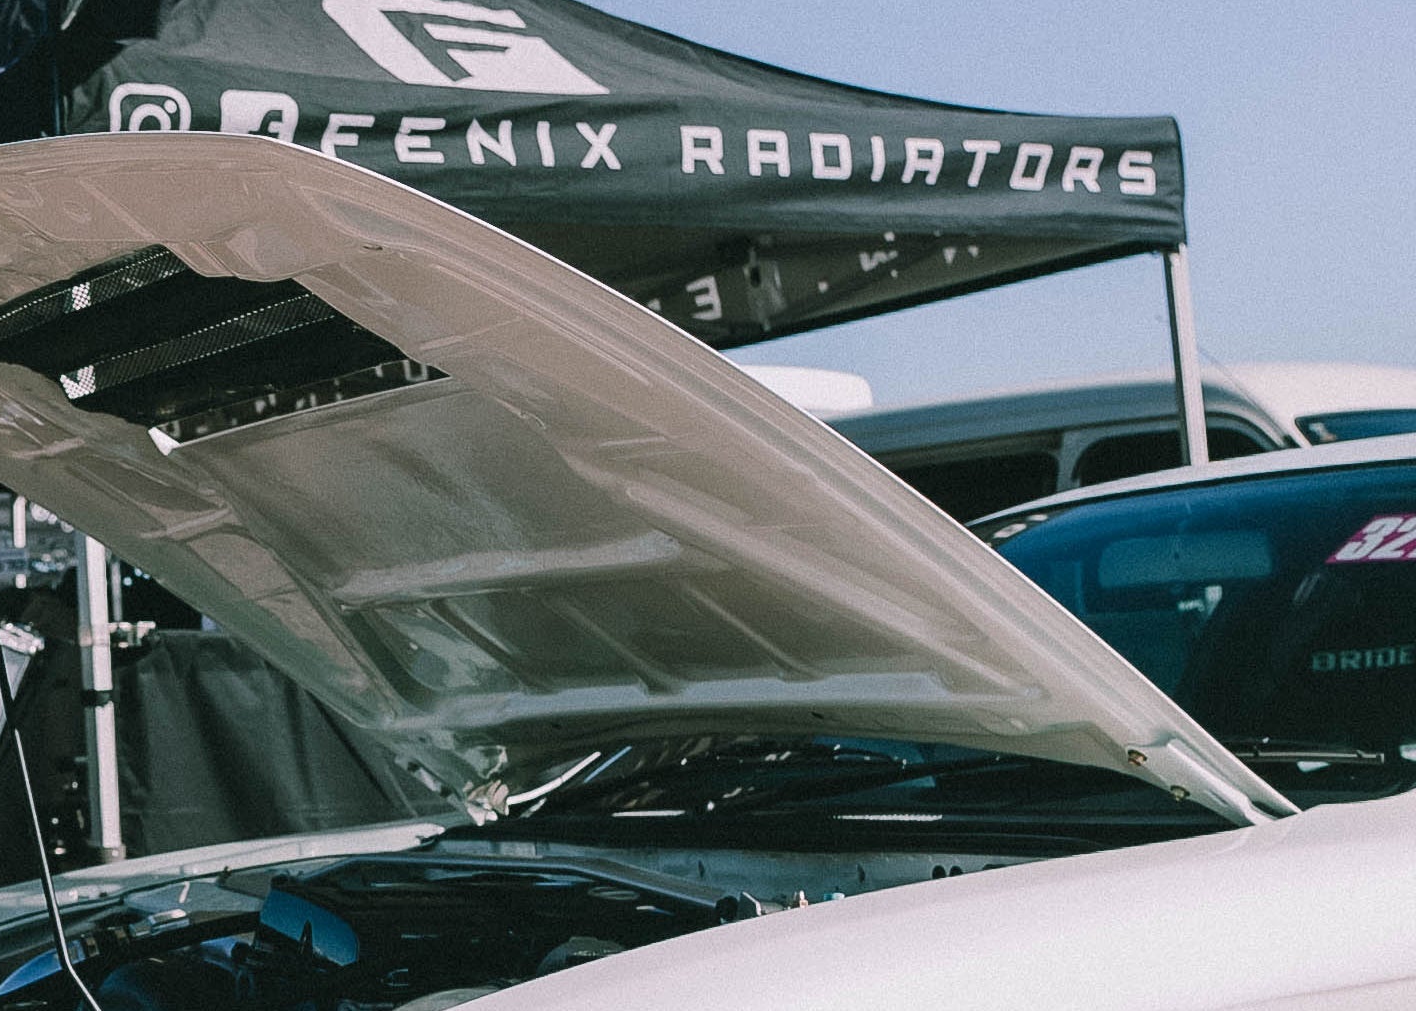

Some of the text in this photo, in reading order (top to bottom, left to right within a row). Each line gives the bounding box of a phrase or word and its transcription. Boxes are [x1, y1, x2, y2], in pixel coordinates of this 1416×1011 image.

[319, 113, 1157, 196] FENIX RADIATORS
[1332, 514, 1416, 561] 32
